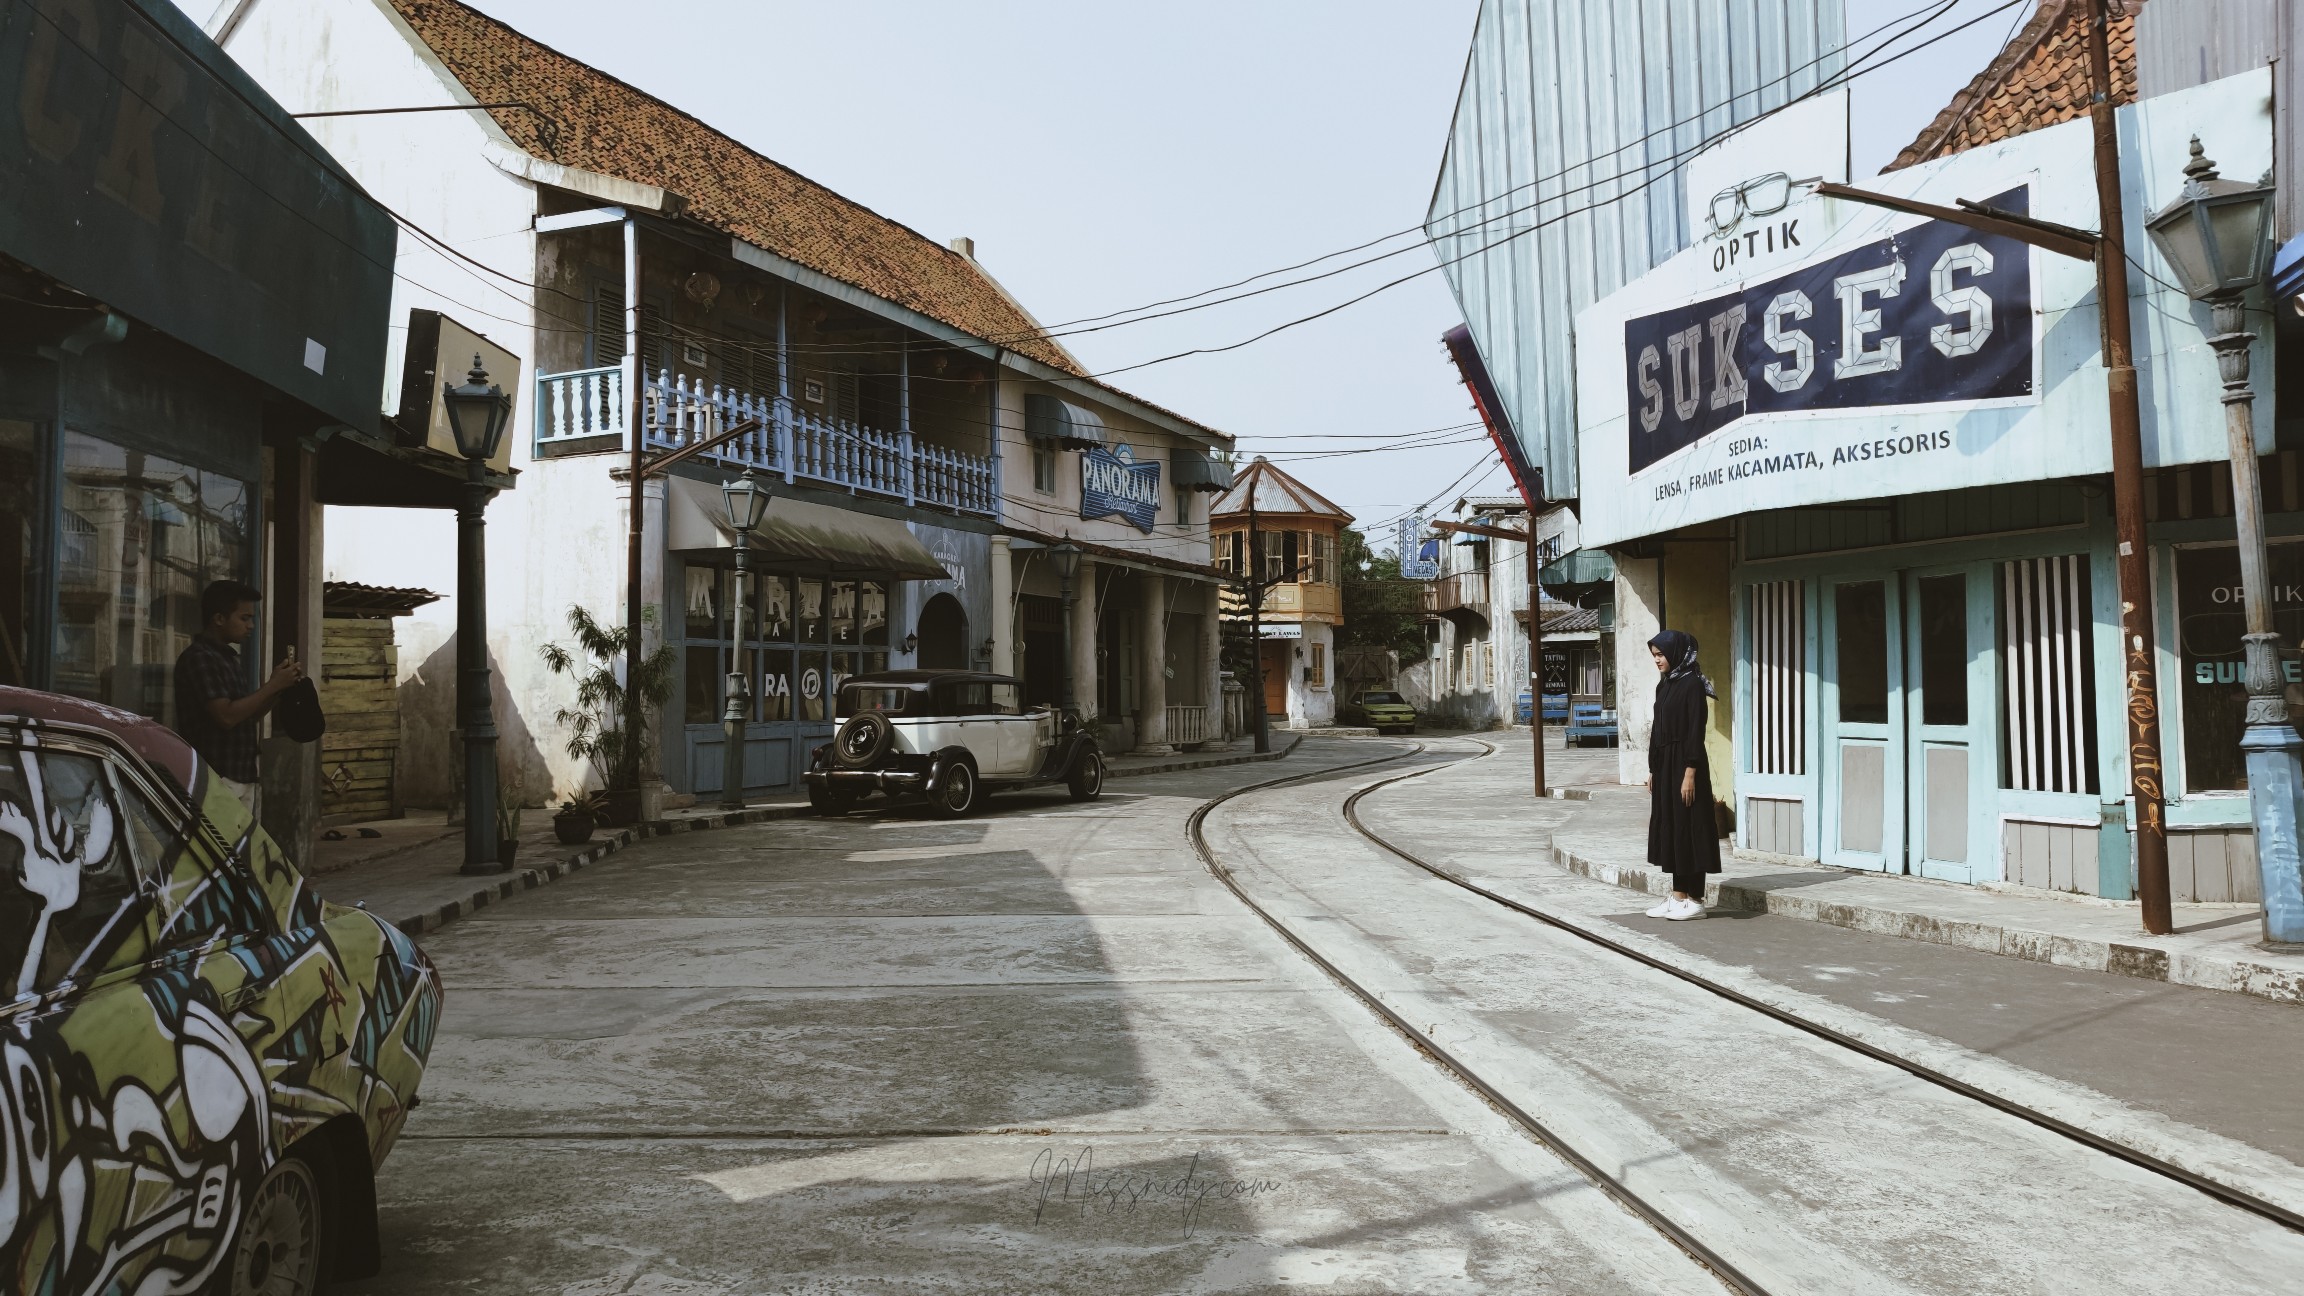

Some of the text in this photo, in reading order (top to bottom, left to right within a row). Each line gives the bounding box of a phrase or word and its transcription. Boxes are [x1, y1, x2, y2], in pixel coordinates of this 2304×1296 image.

[1712, 218, 1801, 273] OPTIK
[1636, 242, 1996, 434] SUKSES
[1689, 468, 1724, 492] FRAME
[1728, 450, 1824, 482] KACAMATA,
[1832, 430, 1952, 469] AKSESORIS
[1728, 435, 1769, 458] SEDIA:
[1082, 456, 1161, 508] PANORAMA
[933, 551, 957, 562] KARAOKE
[1405, 524, 1414, 571] MOTEL
[1413, 565, 1433, 575] VEGAS
[2211, 585, 2304, 604] OPIK
[1544, 654, 1566, 662] TATTOO
